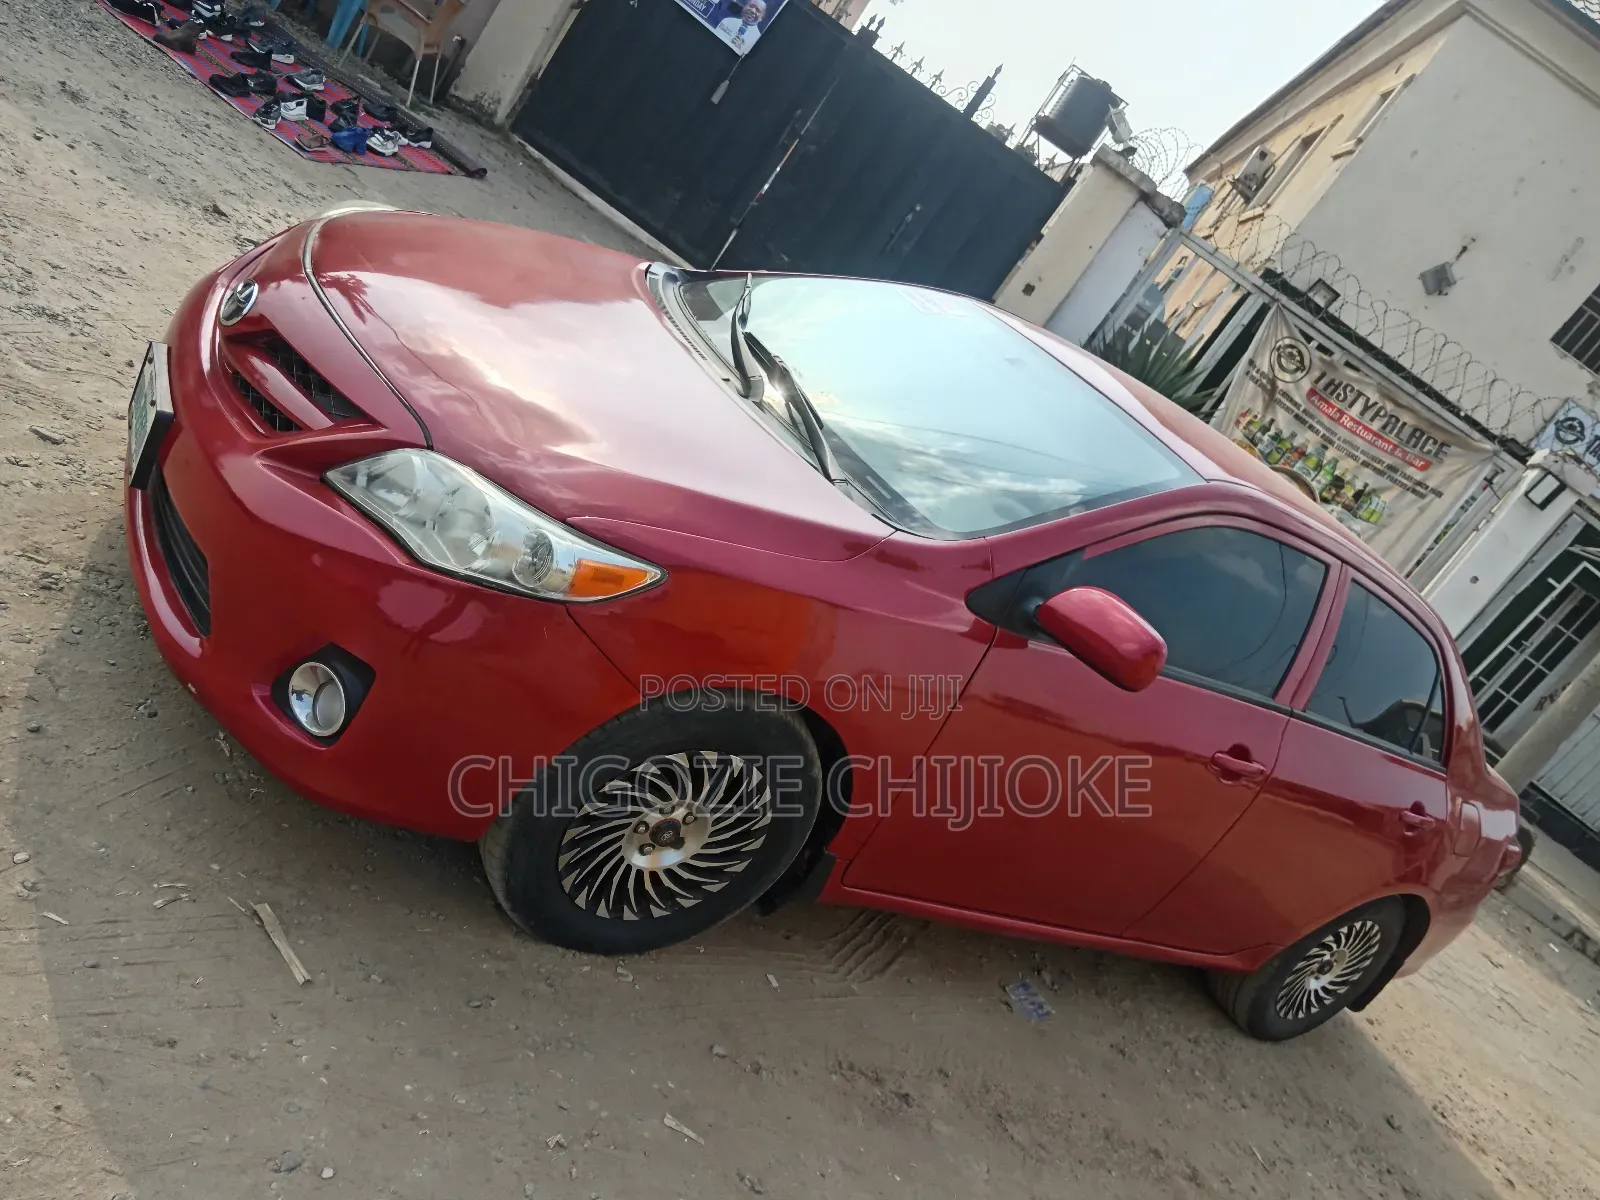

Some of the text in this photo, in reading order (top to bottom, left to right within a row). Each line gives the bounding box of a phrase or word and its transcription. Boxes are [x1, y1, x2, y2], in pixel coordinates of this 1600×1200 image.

[1310, 396, 1425, 468] Amala Restuarant & Bar
